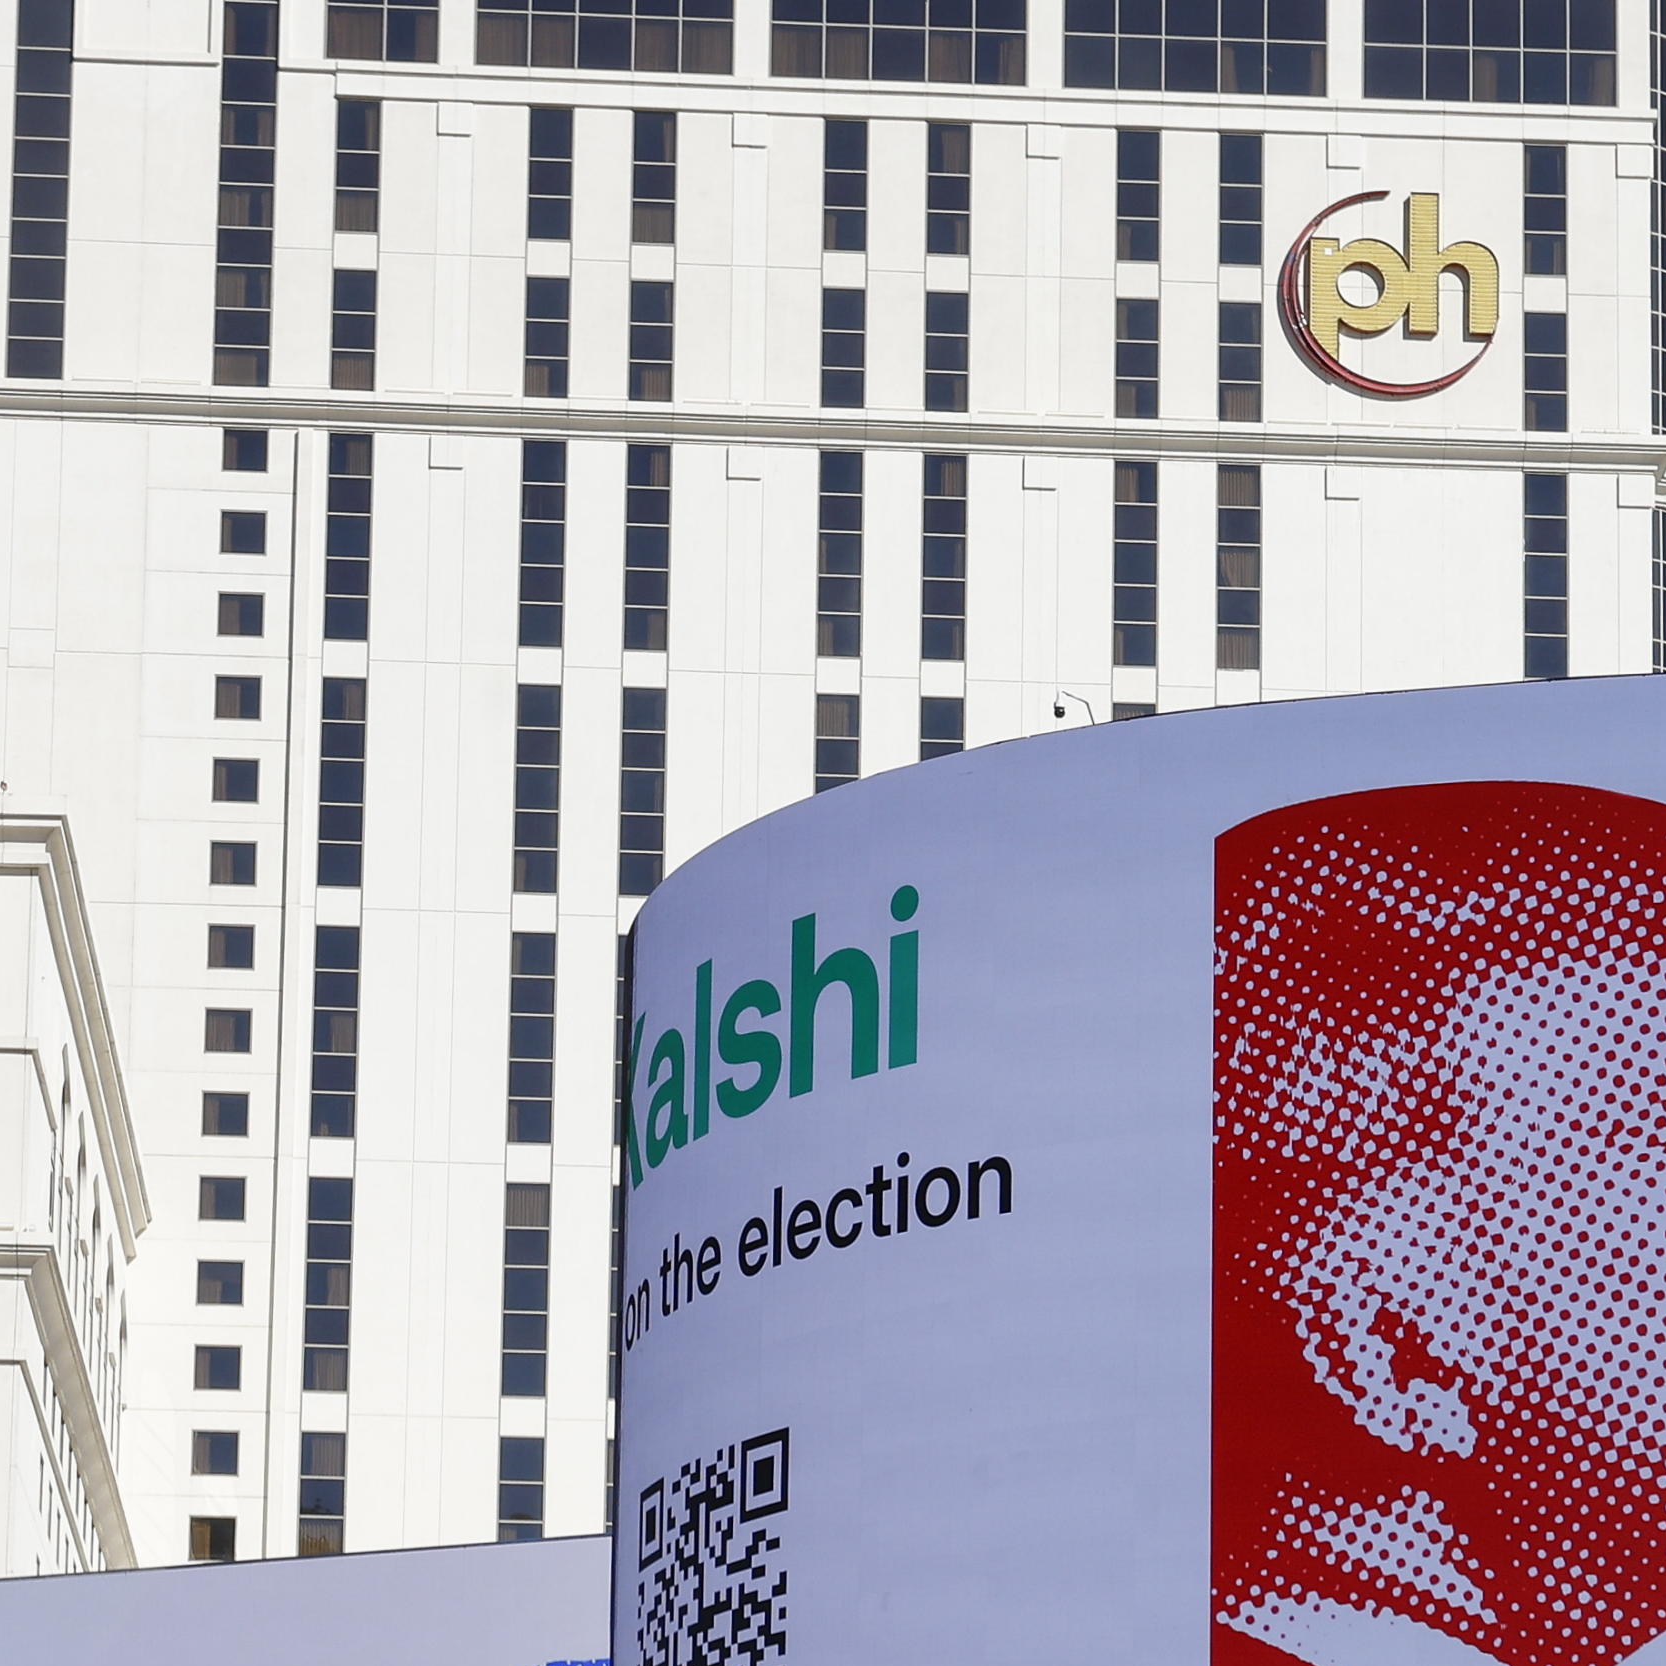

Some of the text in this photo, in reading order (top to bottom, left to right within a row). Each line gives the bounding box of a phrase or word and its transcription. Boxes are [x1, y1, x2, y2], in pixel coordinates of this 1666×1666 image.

[1310, 193, 1499, 362] ph
[624, 1151, 1013, 1353] on the election
